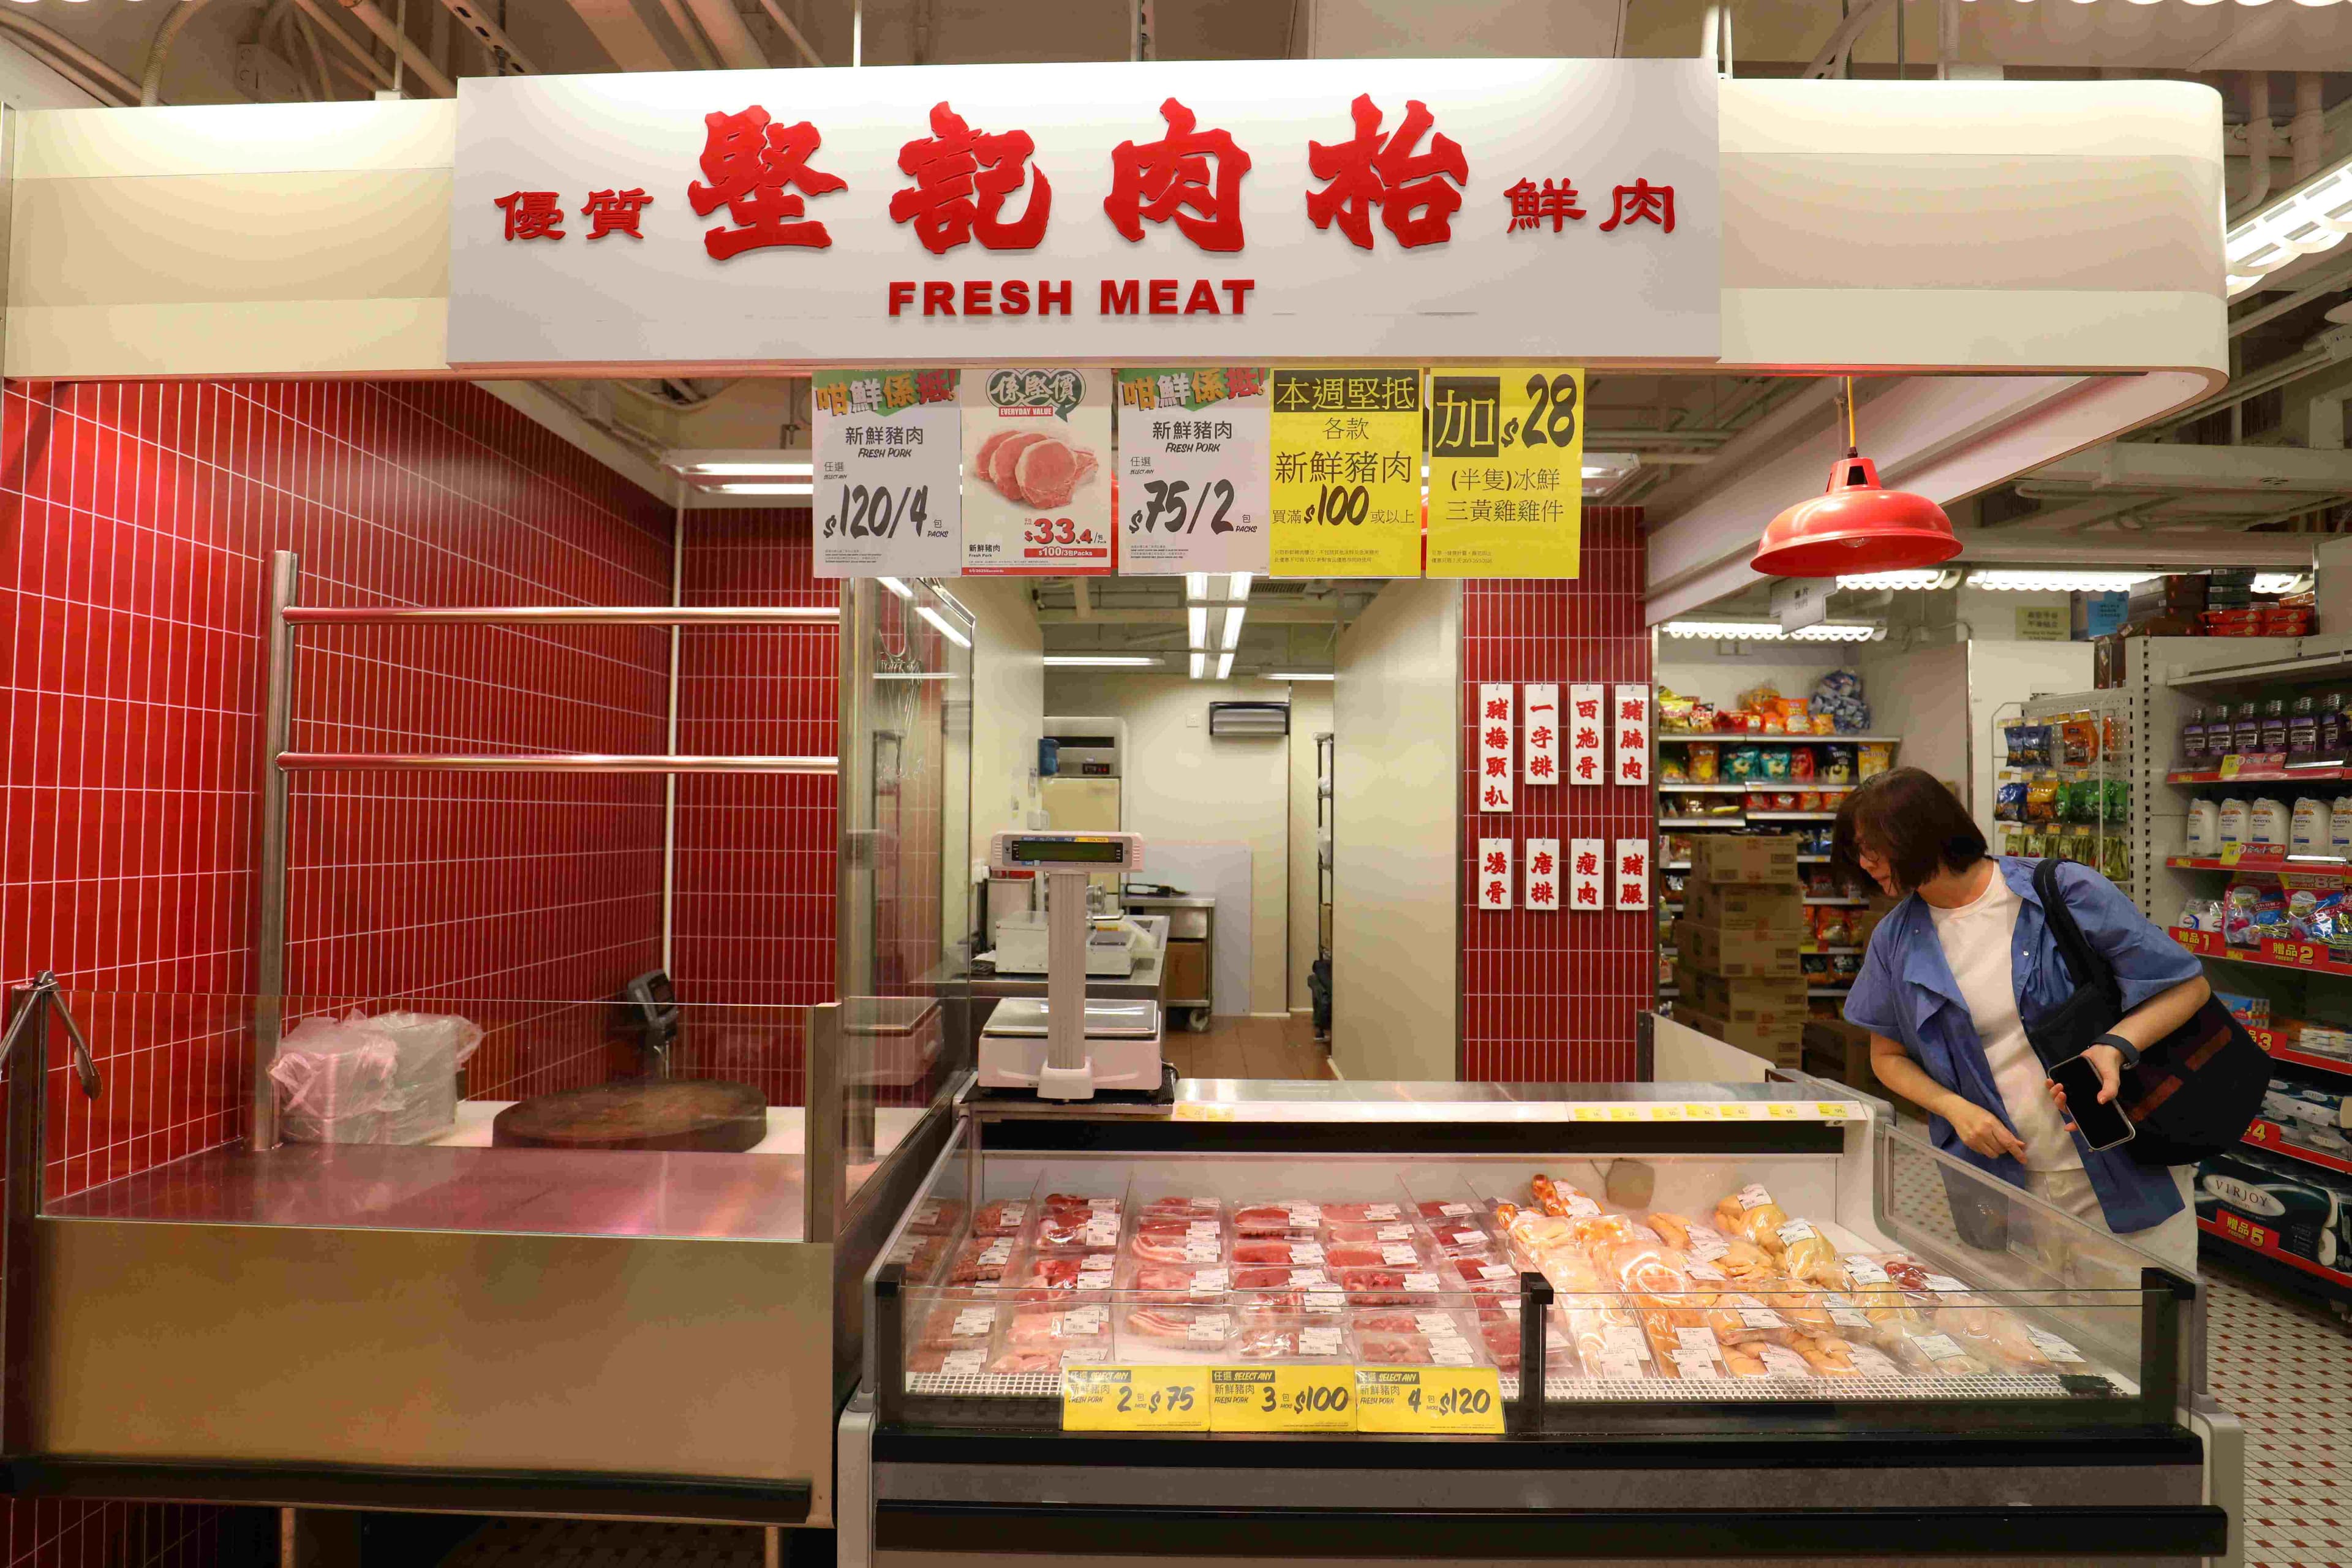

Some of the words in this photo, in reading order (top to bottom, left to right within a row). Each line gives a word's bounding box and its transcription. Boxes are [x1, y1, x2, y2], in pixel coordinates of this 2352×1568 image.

[493, 186, 654, 241] 優質
[687, 92, 1469, 262] 堅記肉枱
[1504, 176, 1676, 234] 鮮肉
[888, 279, 1072, 317] FRESH
[1101, 279, 1254, 315] MEAT
[1276, 377, 1415, 411] 本週堅抵
[1435, 390, 1496, 449] 加
[1501, 373, 1578, 449] $28
[845, 426, 924, 445] 新鮮豬肉
[1152, 421, 1232, 440] 新鮮豬肉
[1322, 417, 1370, 441] 各款
[858, 448, 886, 458] FRESH
[888, 448, 912, 458] PORK
[1165, 443, 1194, 453] FRESH
[1195, 442, 1220, 453] PORK
[824, 461, 844, 472] 任選
[1129, 456, 1152, 467] 任選
[1274, 450, 1412, 484] 新鮮豬肉
[1242, 514, 1251, 523] 包
[969, 544, 1001, 552] 新鮮豬肉
[1529, 704, 1554, 778] 一字排
[1575, 699, 1599, 780] 西施骨
[1619, 698, 1645, 780] 豬腩肉
[1575, 852, 1599, 905] 瘦肉
[2273, 942, 2297, 957] 贈品
[2299, 946, 2313, 966] 2
[2258, 1033, 2272, 1051] 3
[2252, 1123, 2266, 1142] 4
[2215, 1180, 2268, 1207] VIRJOY
[2226, 1217, 2249, 1237] 贈品
[2250, 1227, 2265, 1246] 5
[1090, 1371, 1112, 1380] SELECT
[1113, 1371, 1129, 1380] ANY
[1234, 1372, 1256, 1381] SELECT
[1258, 1372, 1273, 1381] ANY
[1378, 1373, 1402, 1382] SELECT
[1117, 1385, 1133, 1412] 2
[1215, 1384, 1255, 1395] 新鮮豬肉
[1261, 1386, 1276, 1412] 3
[1294, 1385, 1349, 1414] $100
[1360, 1385, 1400, 1396] 新鮮豬肉
[1408, 1387, 1421, 1414] 4
[1439, 1387, 1491, 1416] $120
